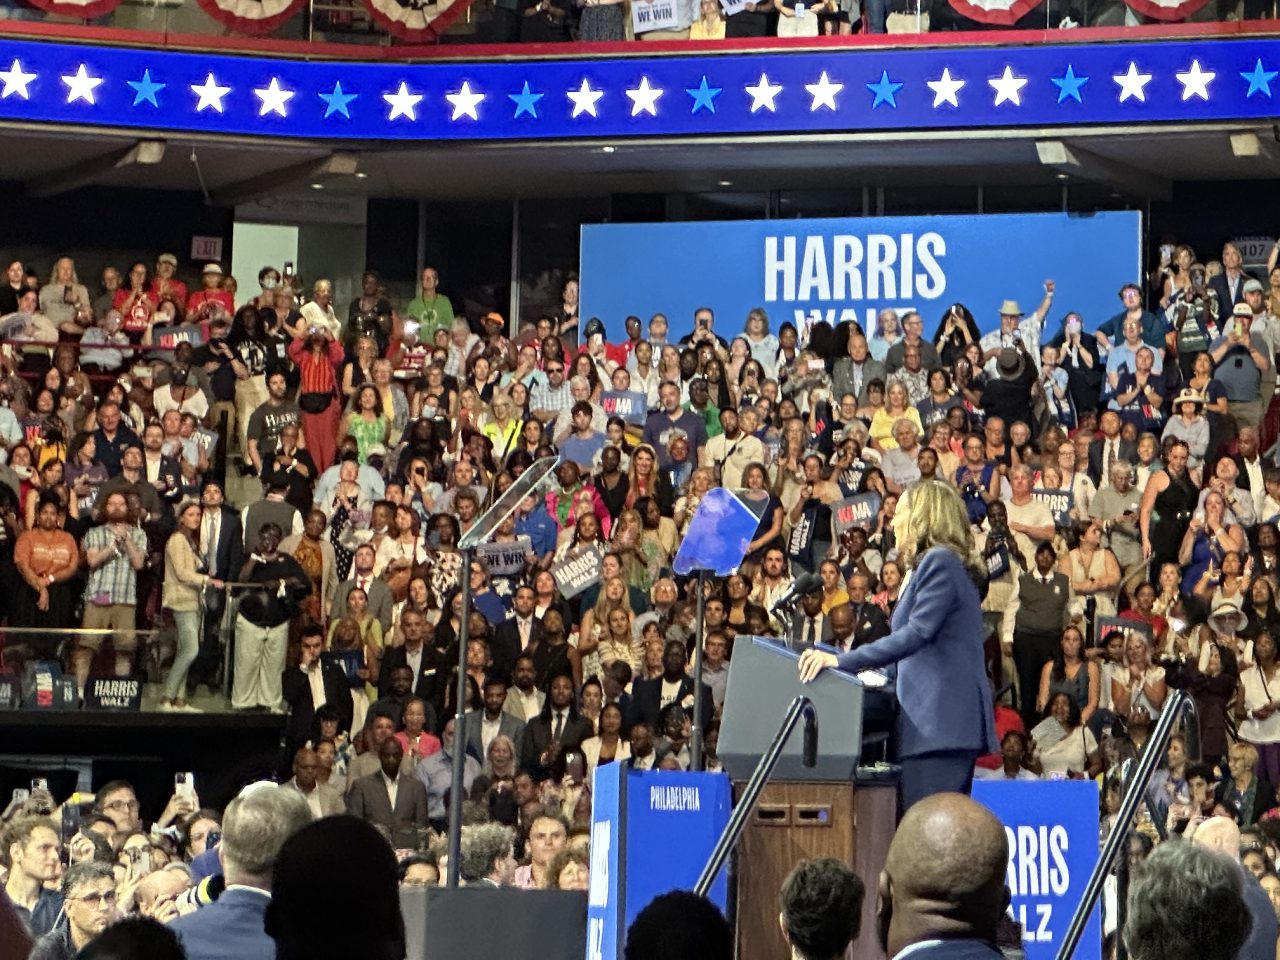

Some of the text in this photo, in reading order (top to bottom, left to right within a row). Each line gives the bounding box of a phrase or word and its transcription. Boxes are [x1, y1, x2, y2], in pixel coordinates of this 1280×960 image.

[637, 7, 673, 22] WE WIN
[1243, 243, 1266, 257] 107
[764, 232, 947, 301] HARRIS
[502, 552, 528, 564] WIN
[555, 551, 599, 585] HARRIS
[570, 567, 600, 589] WALZ
[95, 680, 138, 698] HARRIS
[101, 697, 130, 708] WALZ
[650, 786, 700, 811] PHILADELPHIA
